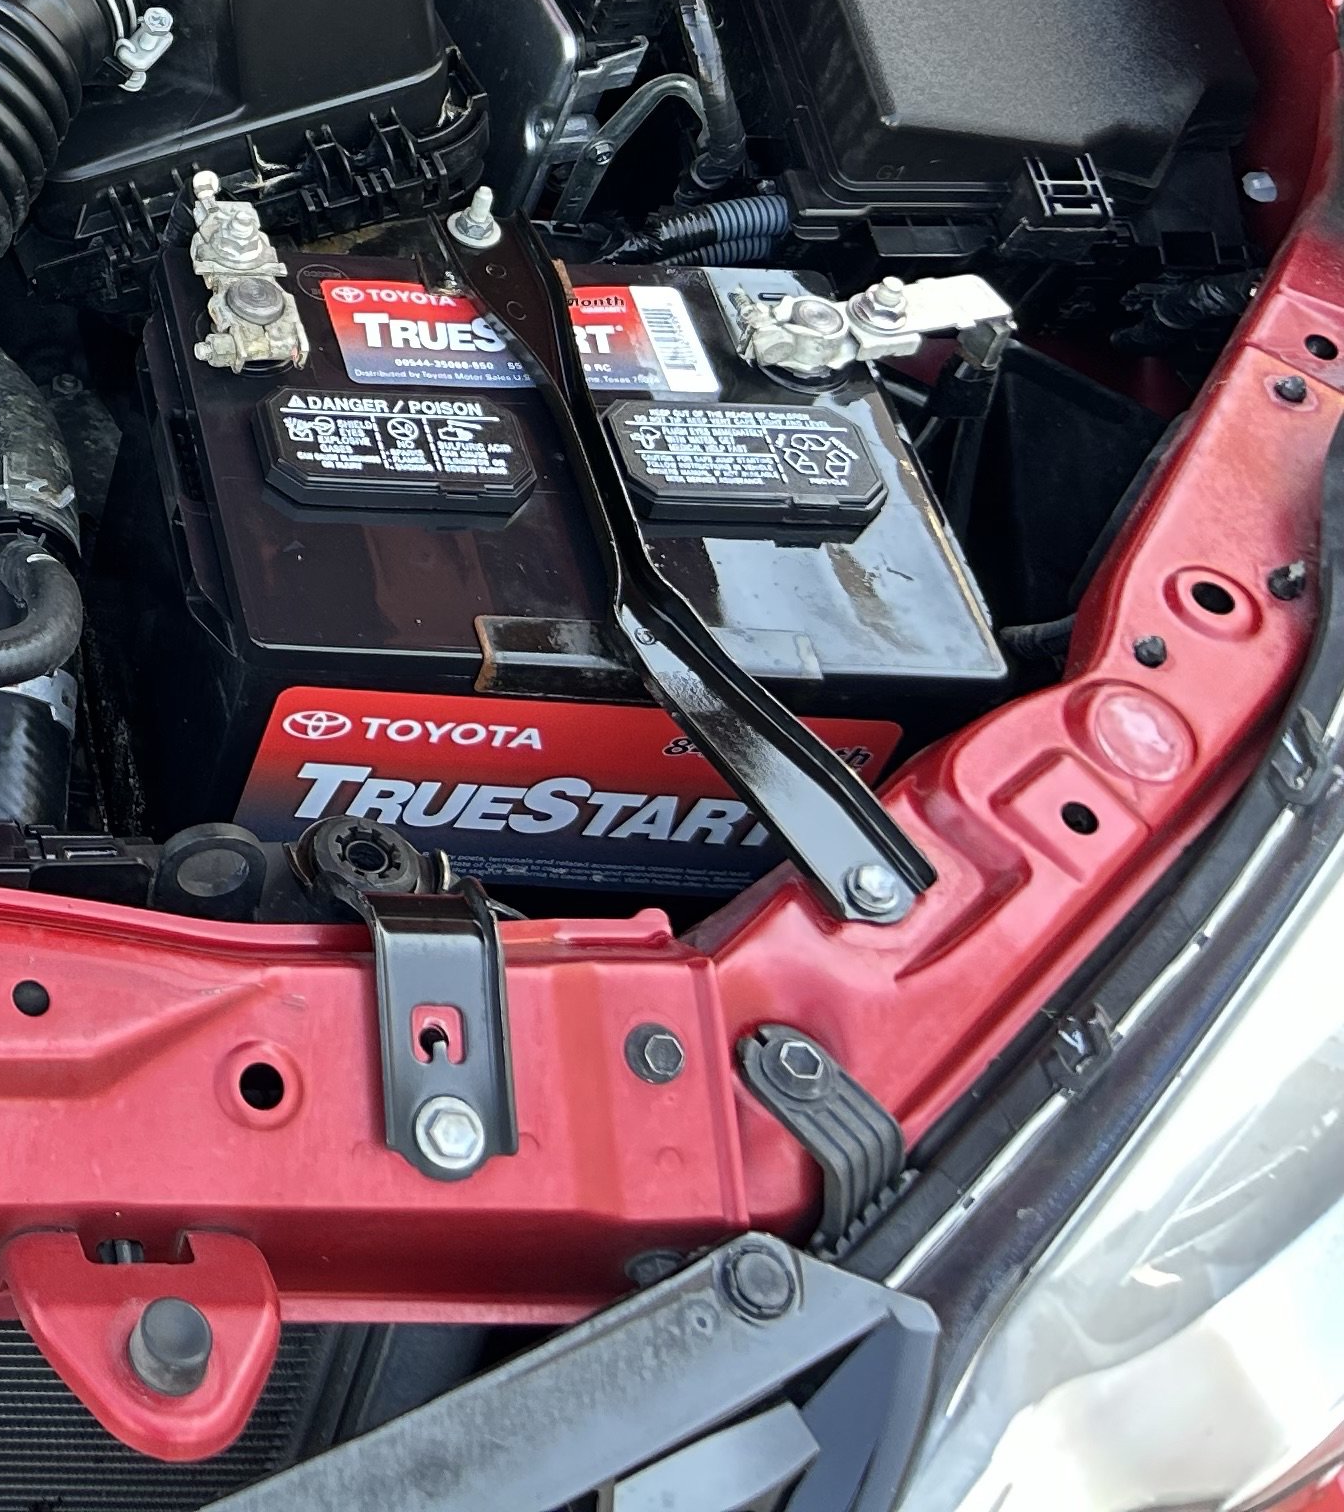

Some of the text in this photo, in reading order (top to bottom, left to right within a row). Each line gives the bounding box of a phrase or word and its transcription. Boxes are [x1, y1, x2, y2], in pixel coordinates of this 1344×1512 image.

[366, 289, 456, 307] TOYOTA
[354, 368, 407, 378] Distributed
[409, 370, 421, 380] by
[421, 370, 453, 380] Toyota
[454, 372, 483, 381] Motor
[306, 396, 484, 417] DANGER / POISON
[361, 716, 543, 751] TOYOTA
